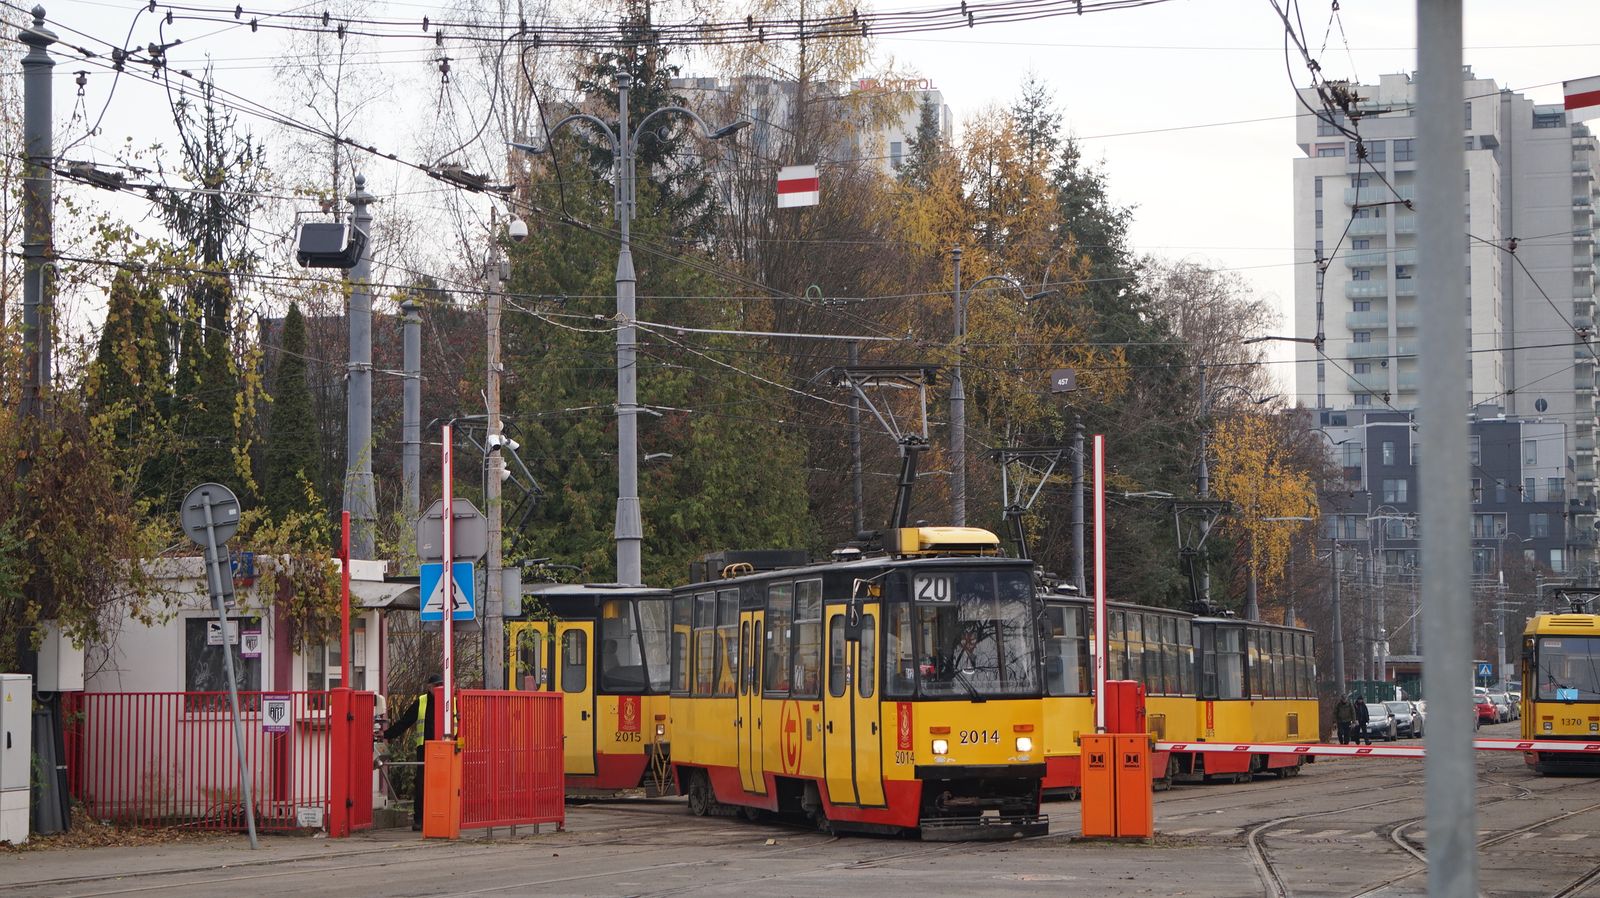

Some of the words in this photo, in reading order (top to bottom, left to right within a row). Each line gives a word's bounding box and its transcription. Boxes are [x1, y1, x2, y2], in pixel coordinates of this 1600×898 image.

[1057, 378, 1069, 386] 457
[918, 577, 948, 601] 20
[1561, 718, 1583, 727] 1370
[615, 731, 642, 743] 2015
[959, 730, 1000, 745] 2014
[895, 751, 915, 765] 2014
